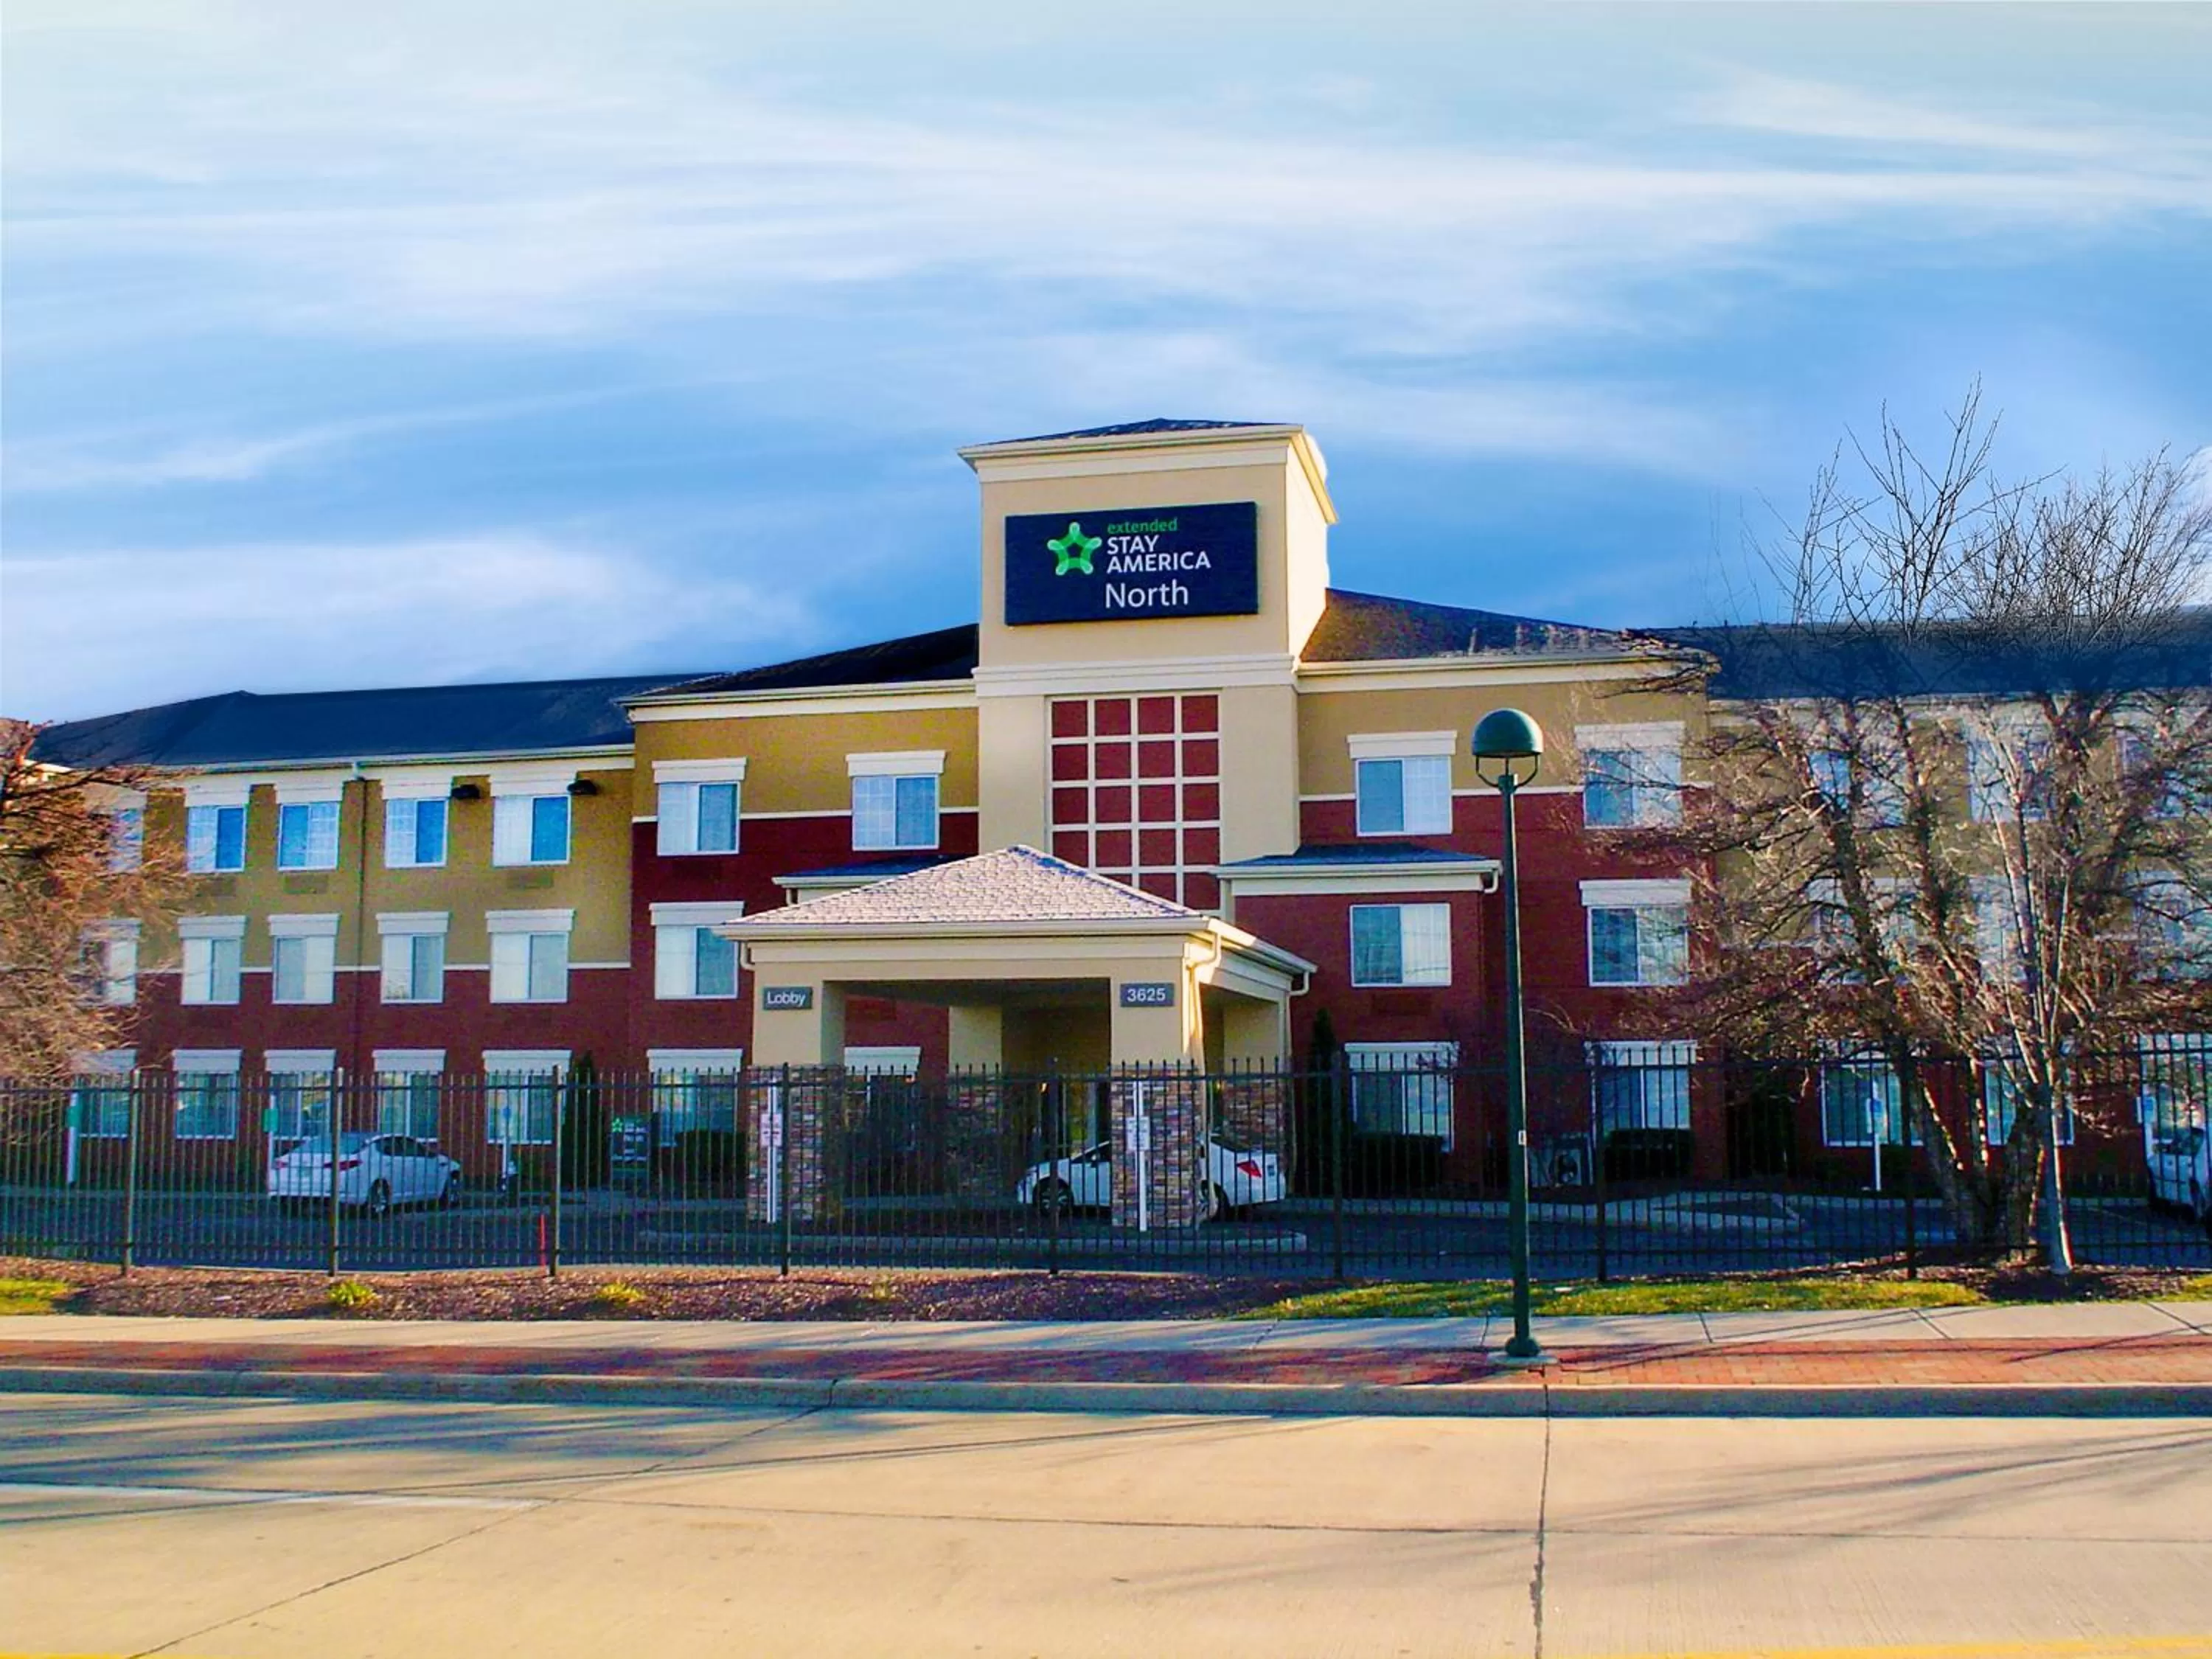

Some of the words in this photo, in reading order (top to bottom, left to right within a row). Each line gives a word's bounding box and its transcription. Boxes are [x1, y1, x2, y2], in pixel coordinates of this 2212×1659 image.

[1107, 518, 1178, 534] extended
[1107, 535, 1159, 554] STAY
[1107, 551, 1211, 574] AMERICA
[1105, 580, 1189, 608] North
[767, 990, 806, 1007] Lobby
[1127, 988, 1166, 1002] 3625
